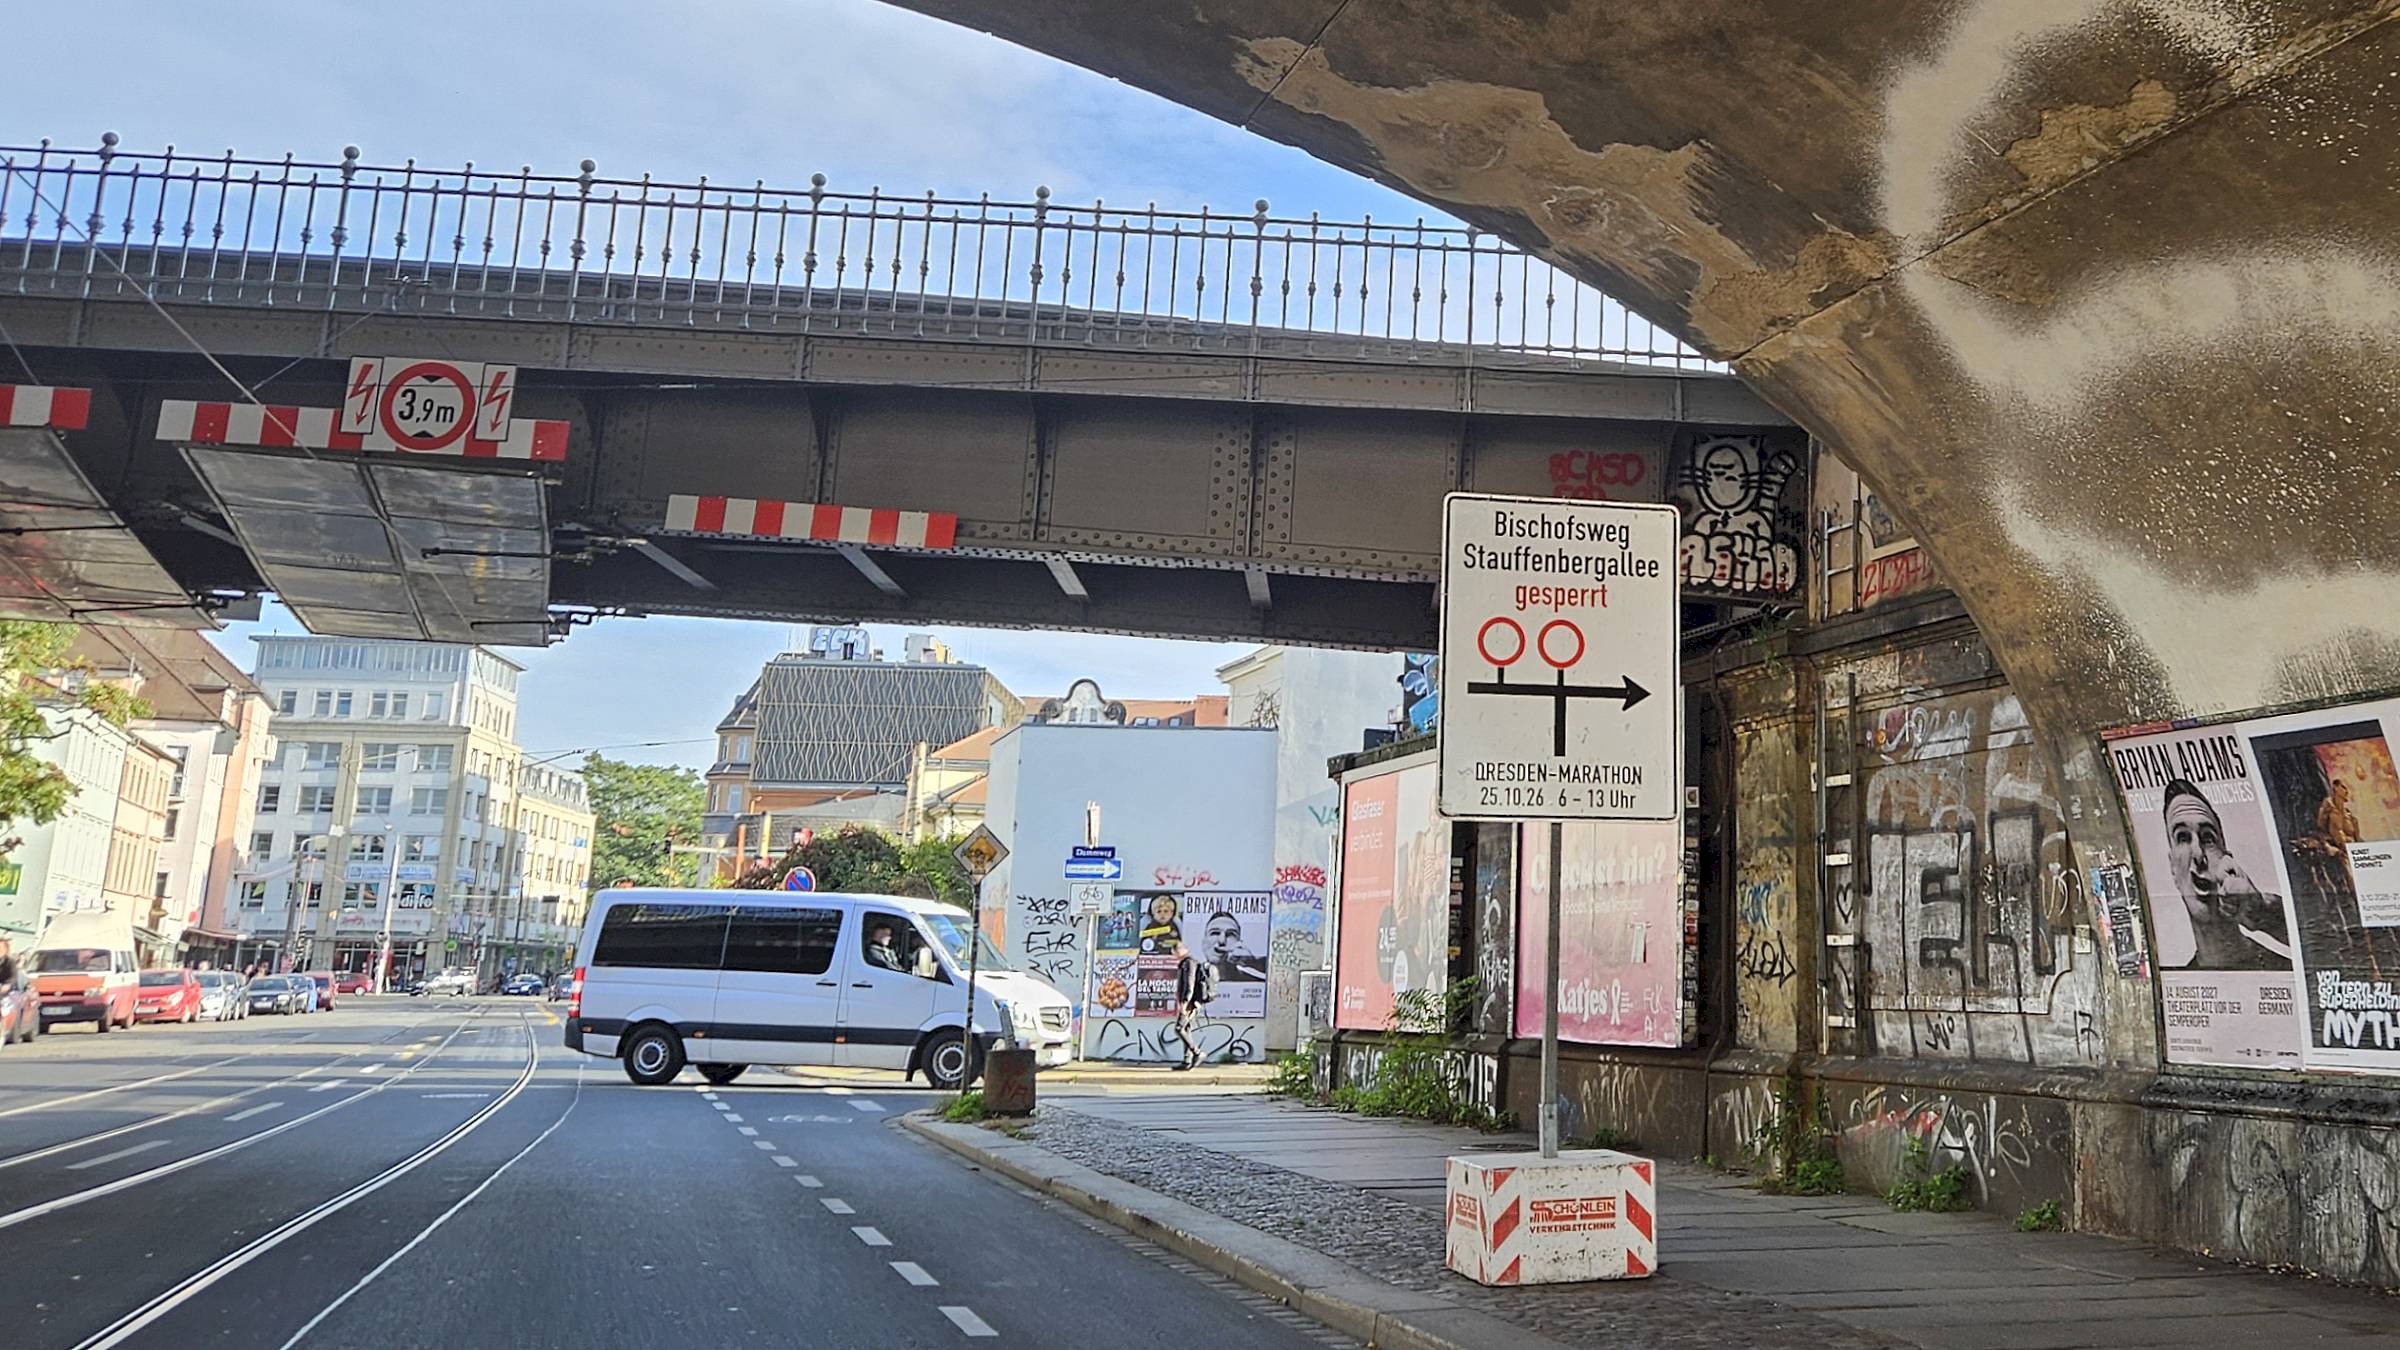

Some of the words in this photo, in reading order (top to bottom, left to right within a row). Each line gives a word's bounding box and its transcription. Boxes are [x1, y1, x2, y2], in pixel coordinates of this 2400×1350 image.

[1495, 511, 1631, 550] Bischofsweg
[1464, 543, 1660, 582] Stauffenbergallee
[1515, 583, 1608, 613] gesperrt
[1475, 761, 1643, 786] DRESDEN-MARATHON
[2114, 743, 2176, 790] BRYAN
[2176, 735, 2247, 784] ADAMS
[1480, 786, 1544, 808] 25.10.26
[1558, 788, 1568, 808] 6
[1589, 789, 1605, 809] 13
[1609, 789, 1637, 810] Uhr
[1186, 895, 1222, 915] BRYAN
[1227, 896, 1267, 914] ADAMS
[1557, 977, 1609, 1024] Katjes
[2175, 986, 2199, 999] AUGUST
[2259, 986, 2293, 1001] DRESDEN
[2167, 1000, 2213, 1015] THEATERPLATZ
[2258, 1002, 2294, 1017] GERMANY
[1529, 1221, 1617, 1235] VERKEHRSTECHNIK
